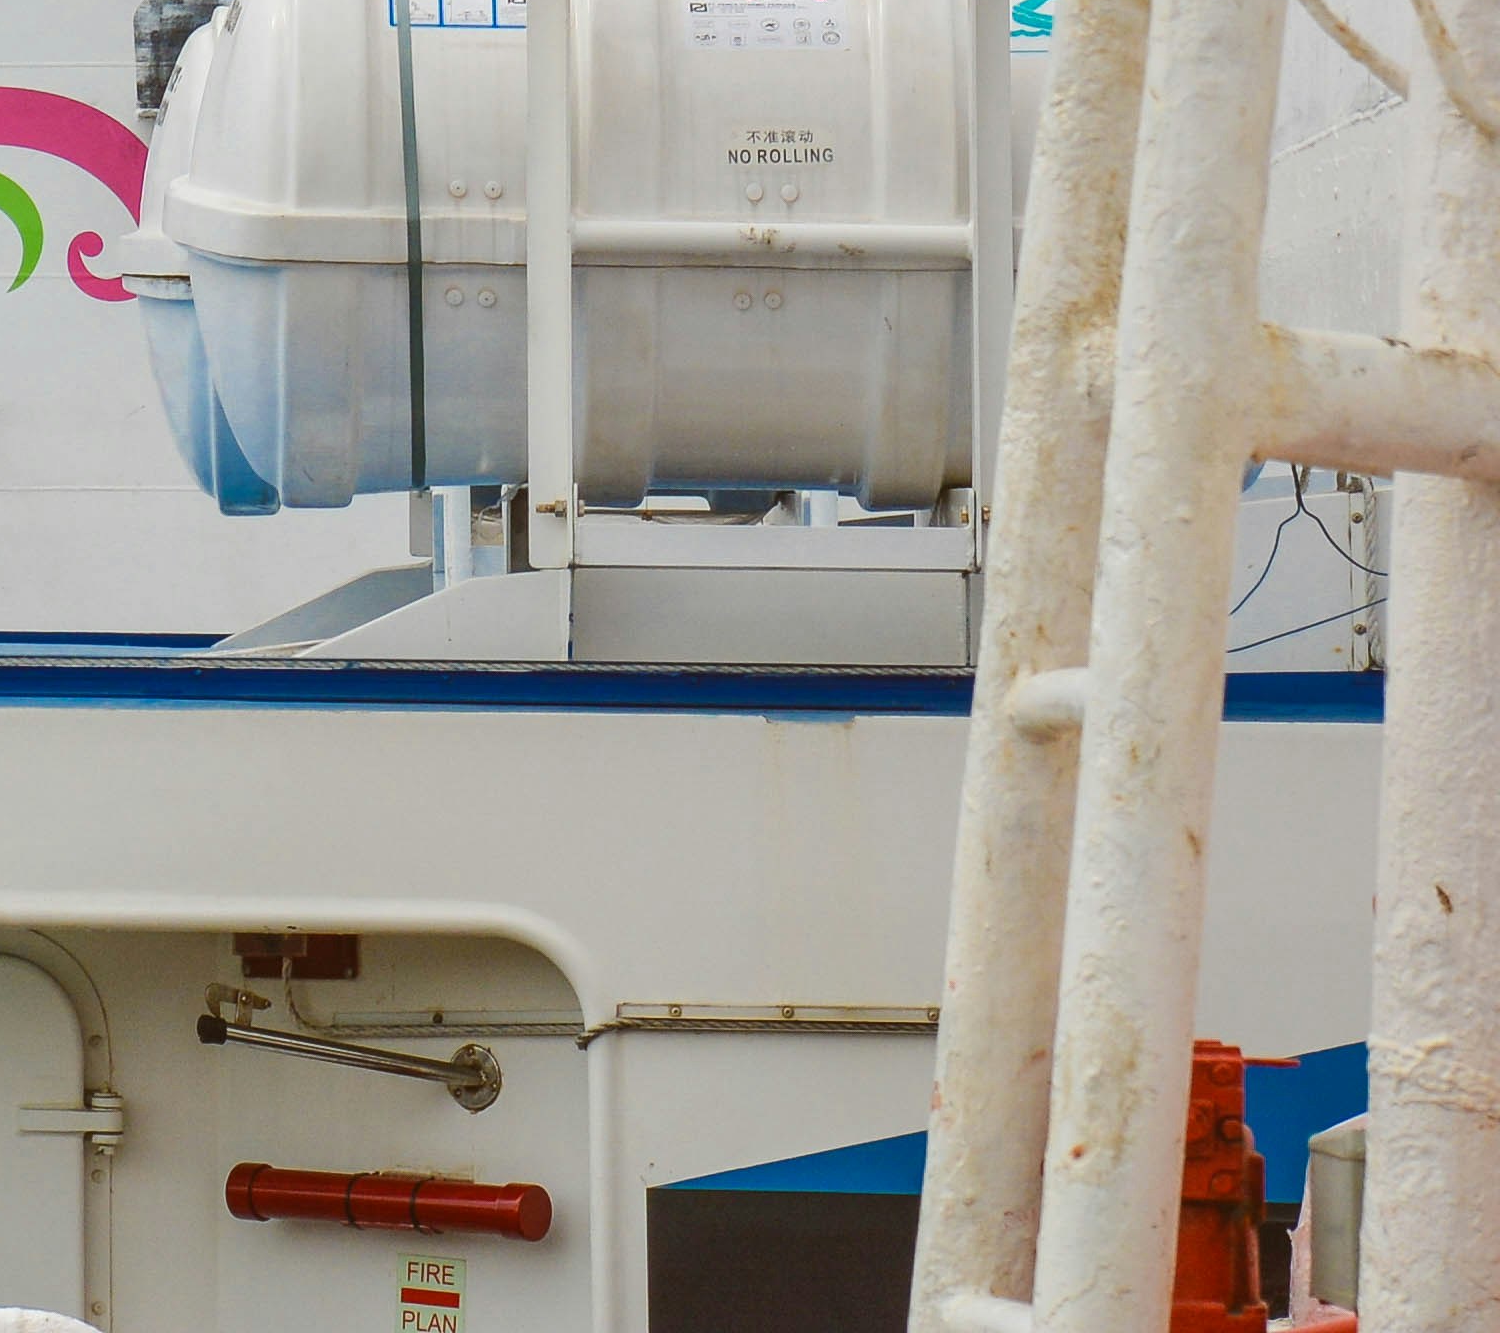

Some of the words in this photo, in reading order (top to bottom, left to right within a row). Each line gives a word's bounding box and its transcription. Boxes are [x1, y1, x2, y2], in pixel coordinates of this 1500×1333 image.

[746, 129, 814, 144] 不准滚动
[728, 149, 751, 164] NO
[757, 147, 834, 164] ROLLING
[407, 1261, 455, 1286] FIRE
[402, 1310, 457, 1333] PLAN
